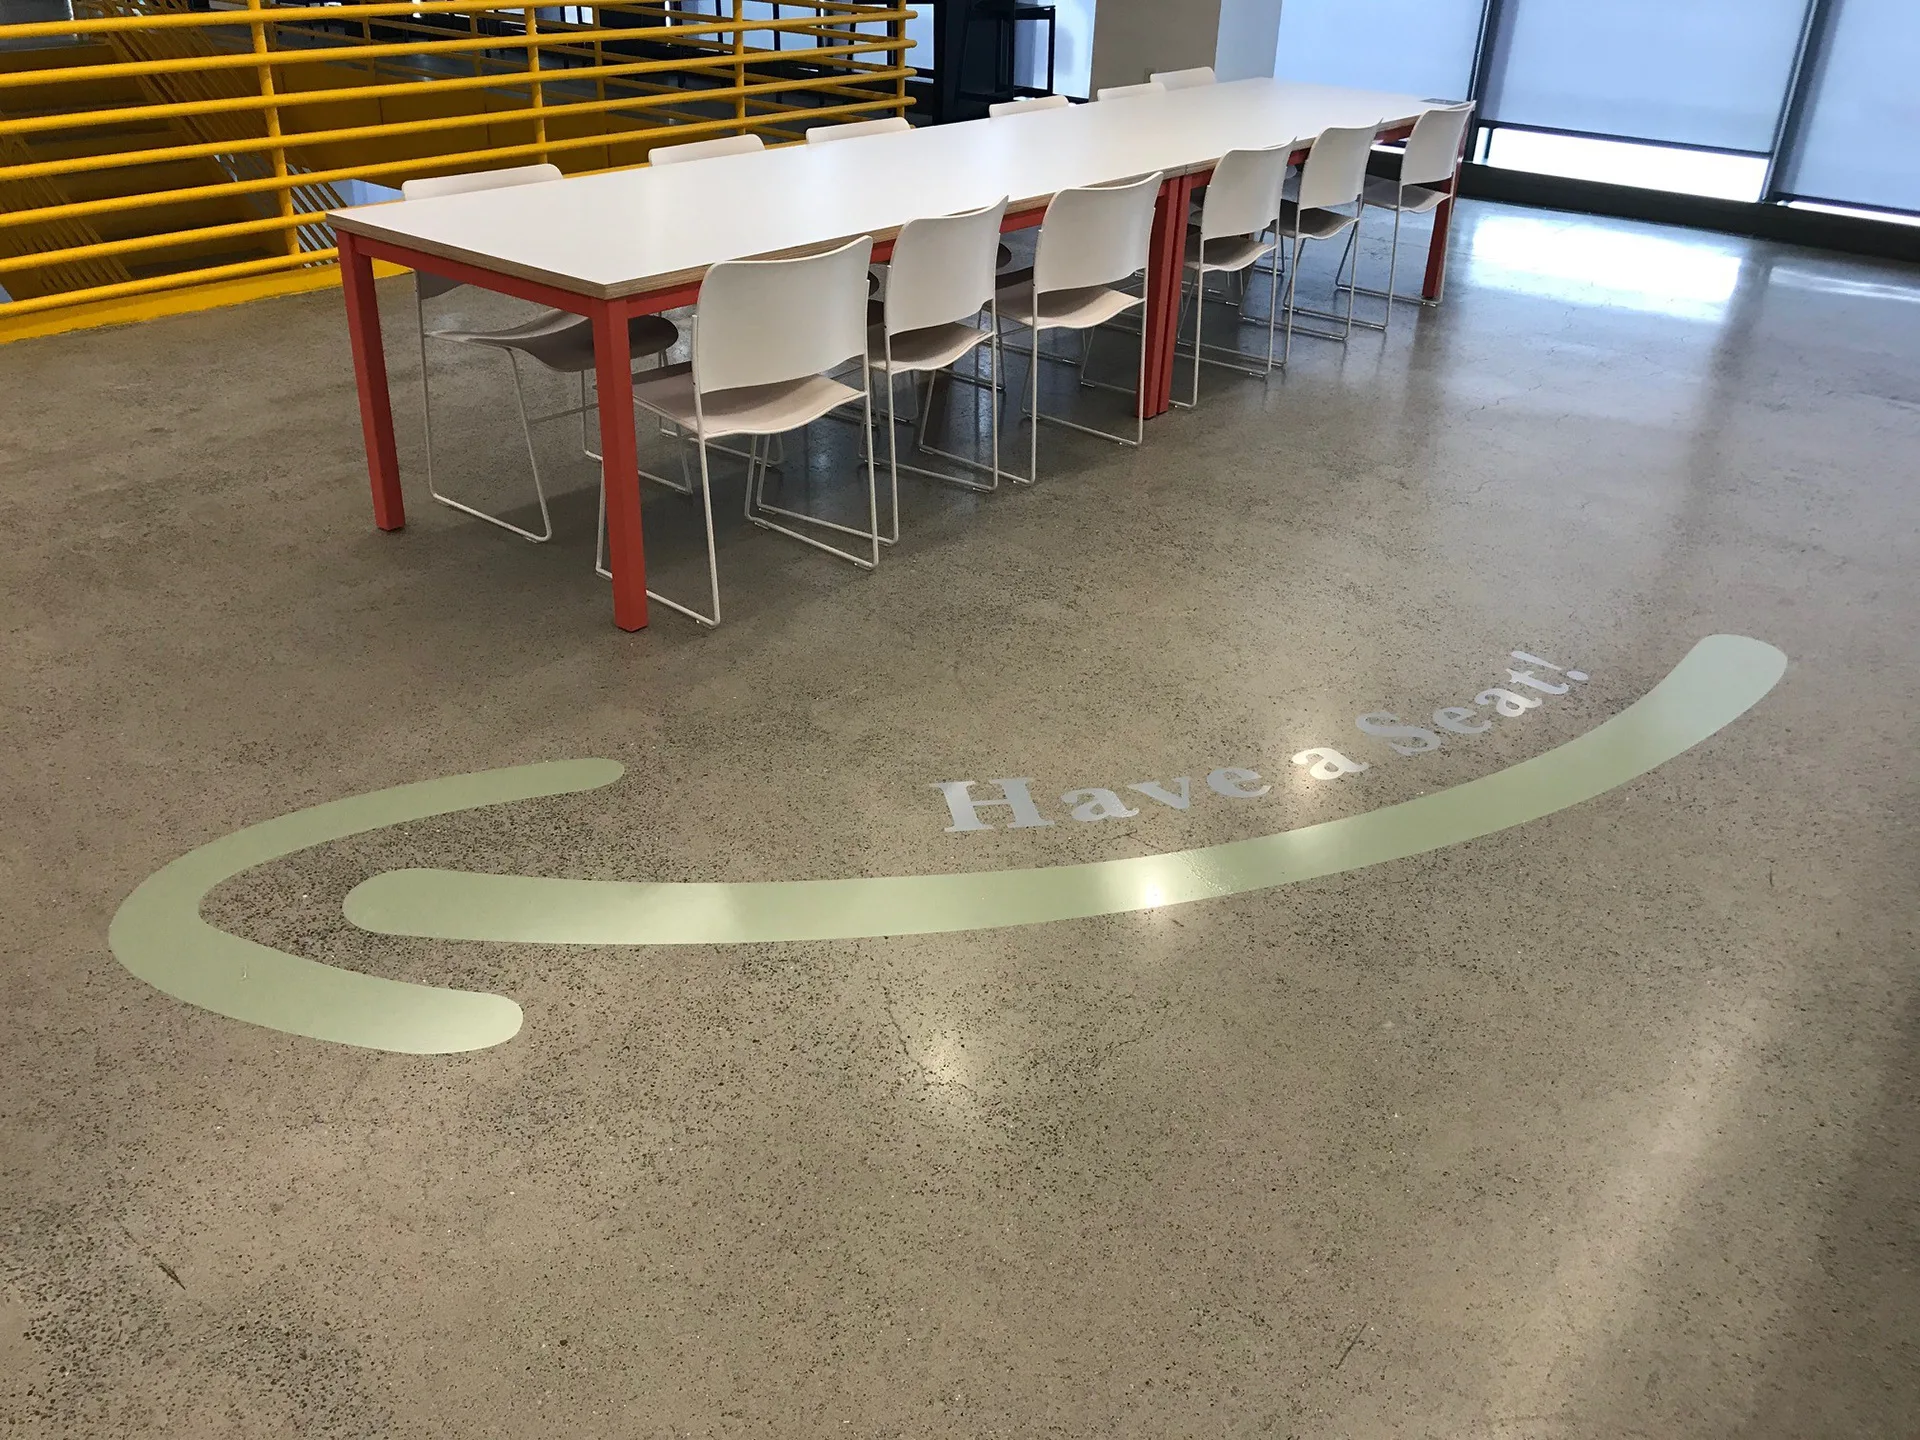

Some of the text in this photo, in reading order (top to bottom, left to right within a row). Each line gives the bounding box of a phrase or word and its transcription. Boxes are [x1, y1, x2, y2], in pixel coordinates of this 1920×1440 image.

[928, 649, 1589, 833] Have a Seat!
